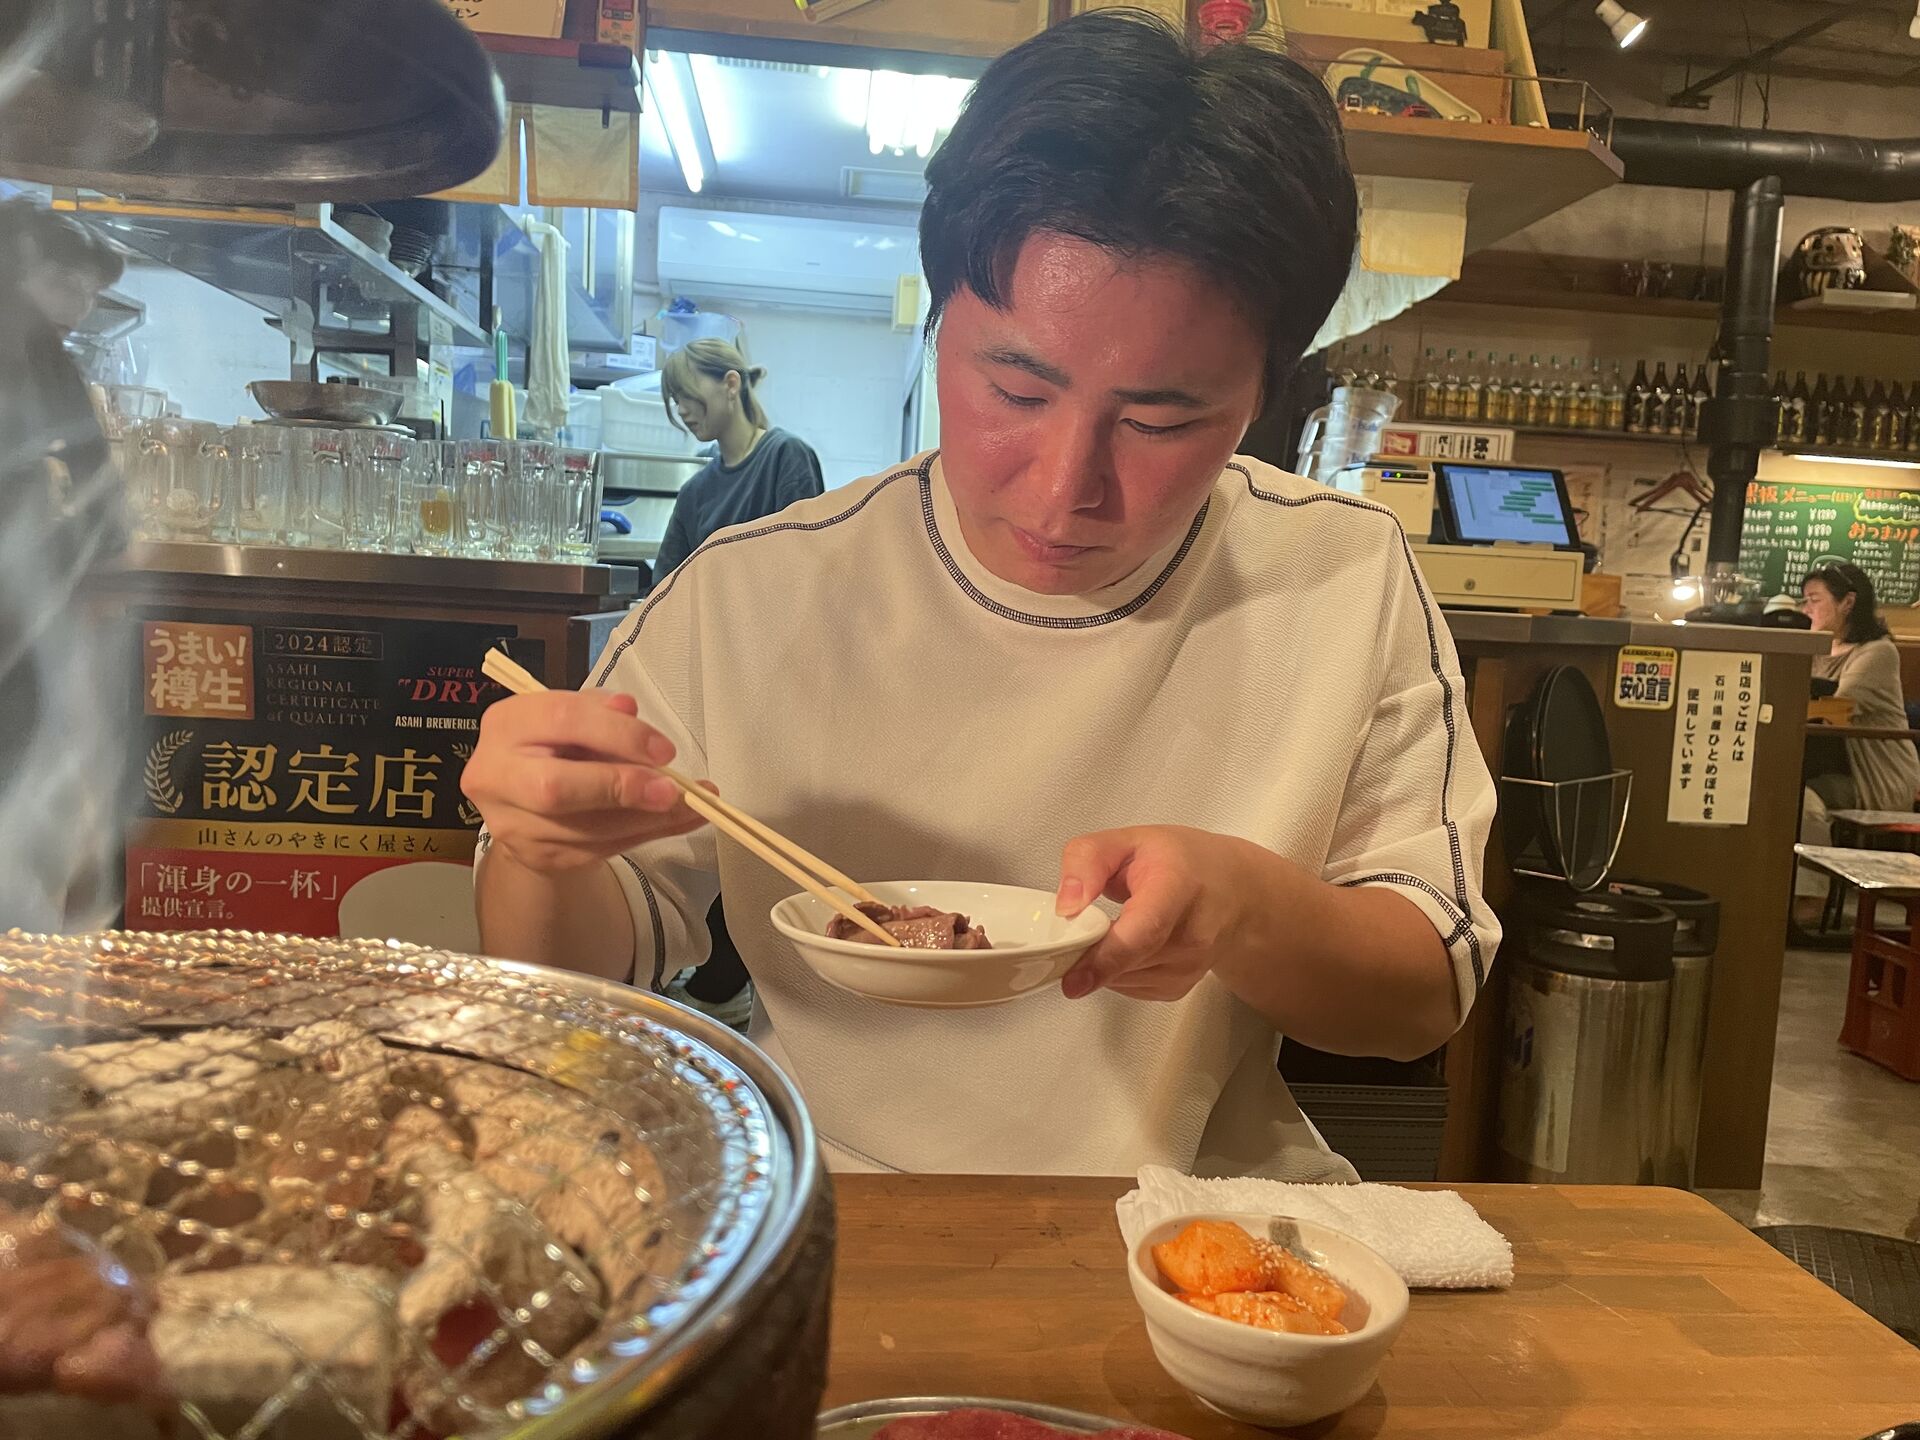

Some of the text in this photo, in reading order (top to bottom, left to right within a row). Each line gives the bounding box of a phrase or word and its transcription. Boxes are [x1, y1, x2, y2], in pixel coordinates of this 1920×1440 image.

[1780, 487, 1831, 505] メニュー
[149, 628, 247, 665] うまい!
[274, 633, 373, 655] 2024認定
[266, 663, 318, 676] ASAHI
[427, 666, 474, 678] SUPER
[151, 666, 247, 712] 樽生
[266, 678, 355, 693] REGIONAL
[1620, 676, 1671, 701] 安心宣言
[266, 694, 382, 710] CERTIFICATE
[1732, 660, 1752, 761] 当店のごはんは
[267, 710, 369, 726] of QUALITY
[395, 715, 423, 727] ASAHI
[1680, 688, 1699, 789] 使用しています
[200, 741, 444, 819] 認定店
[198, 828, 440, 853] 山さんのやきにく屋さん
[140, 862, 338, 901] 「渾身の一杯」
[140, 896, 236, 920] 提供宣言。
